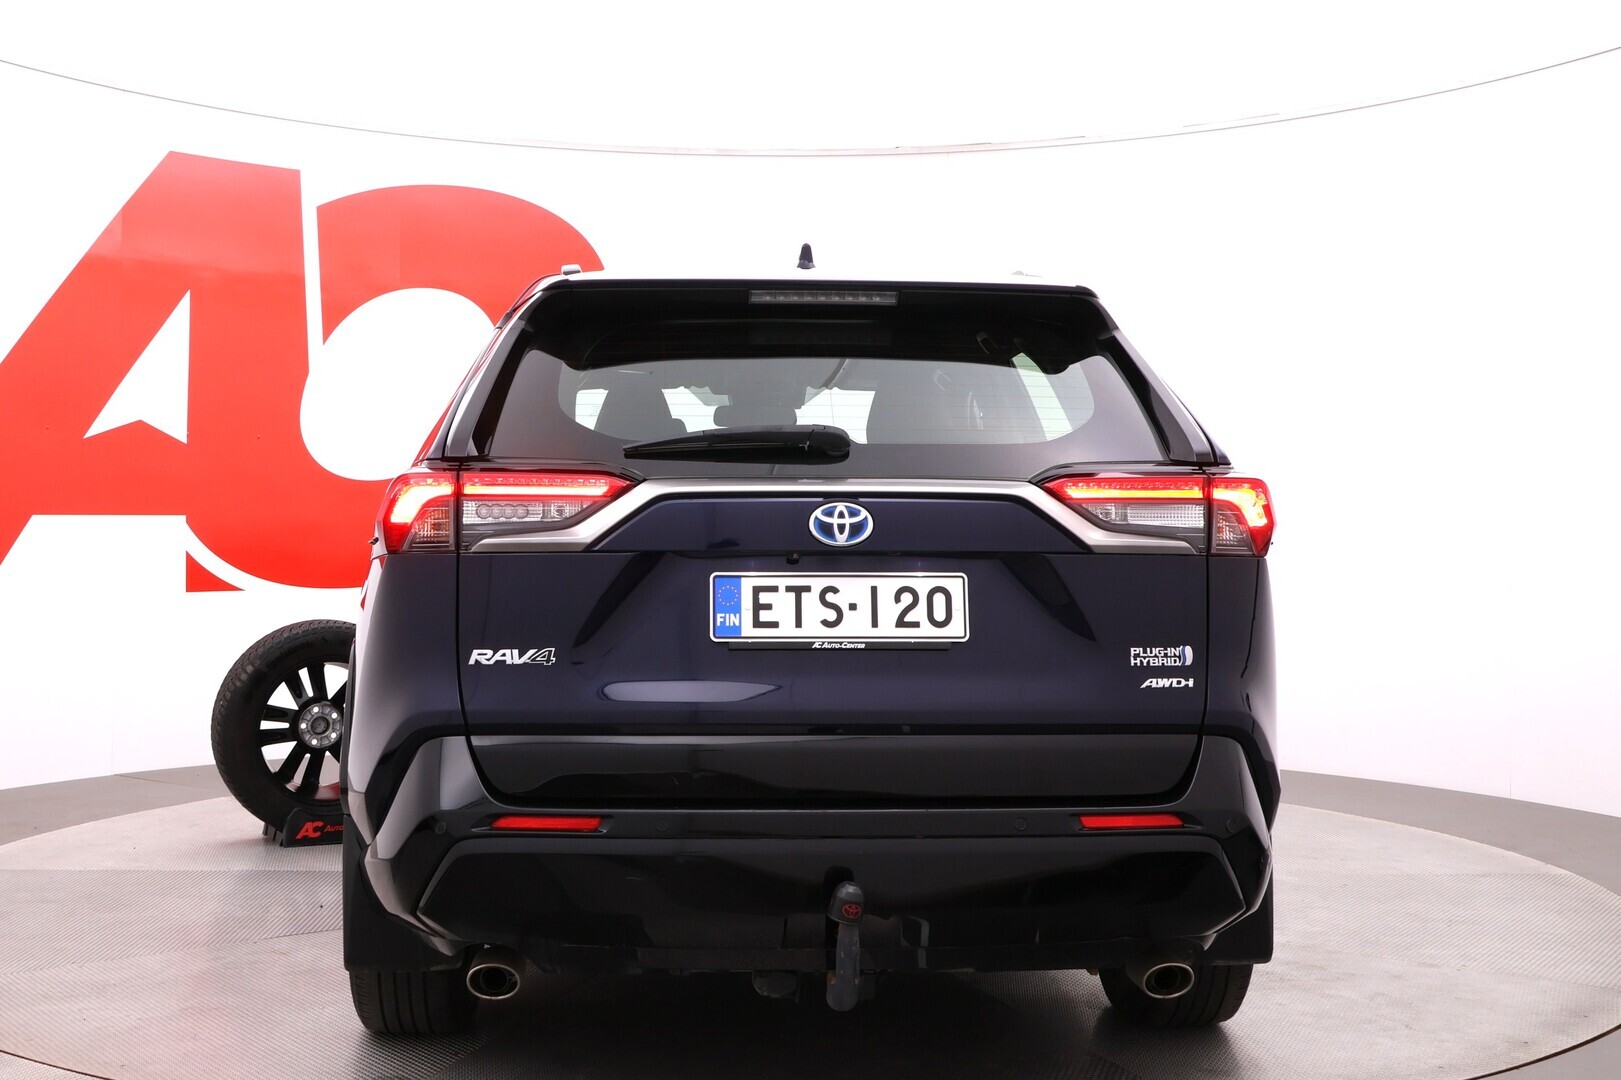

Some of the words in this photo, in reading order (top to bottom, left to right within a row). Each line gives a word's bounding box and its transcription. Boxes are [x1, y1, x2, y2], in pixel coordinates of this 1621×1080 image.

[752, 585, 953, 628] ETS-120
[716, 613, 740, 627] FIN
[468, 647, 556, 666] RAV4
[1130, 647, 1181, 657] PLUG-IN
[1130, 657, 1181, 667] HYBRID
[295, 820, 324, 839] AC
